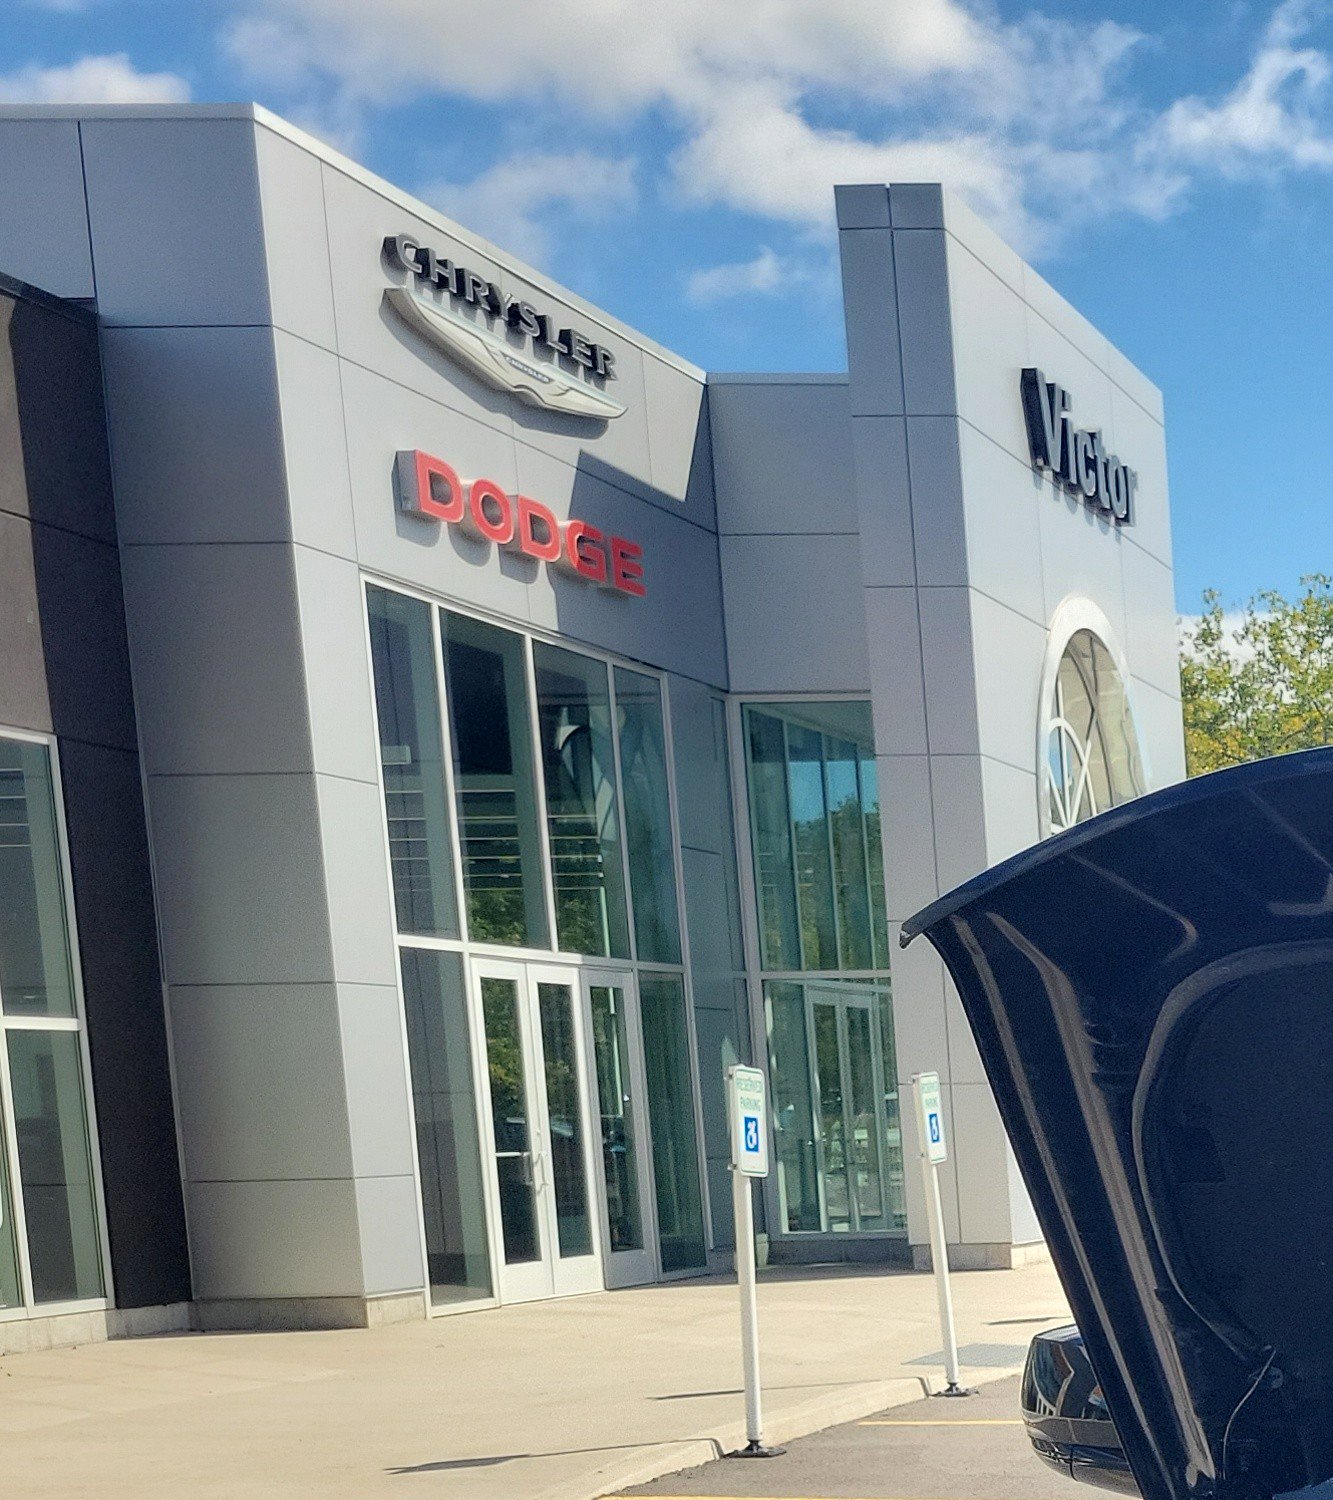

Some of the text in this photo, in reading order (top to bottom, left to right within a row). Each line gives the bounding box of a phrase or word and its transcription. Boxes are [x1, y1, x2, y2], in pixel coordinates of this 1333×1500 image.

[384, 233, 618, 382] CHRYSLER
[1021, 368, 1139, 527] Victor
[397, 449, 647, 597] DODGE
